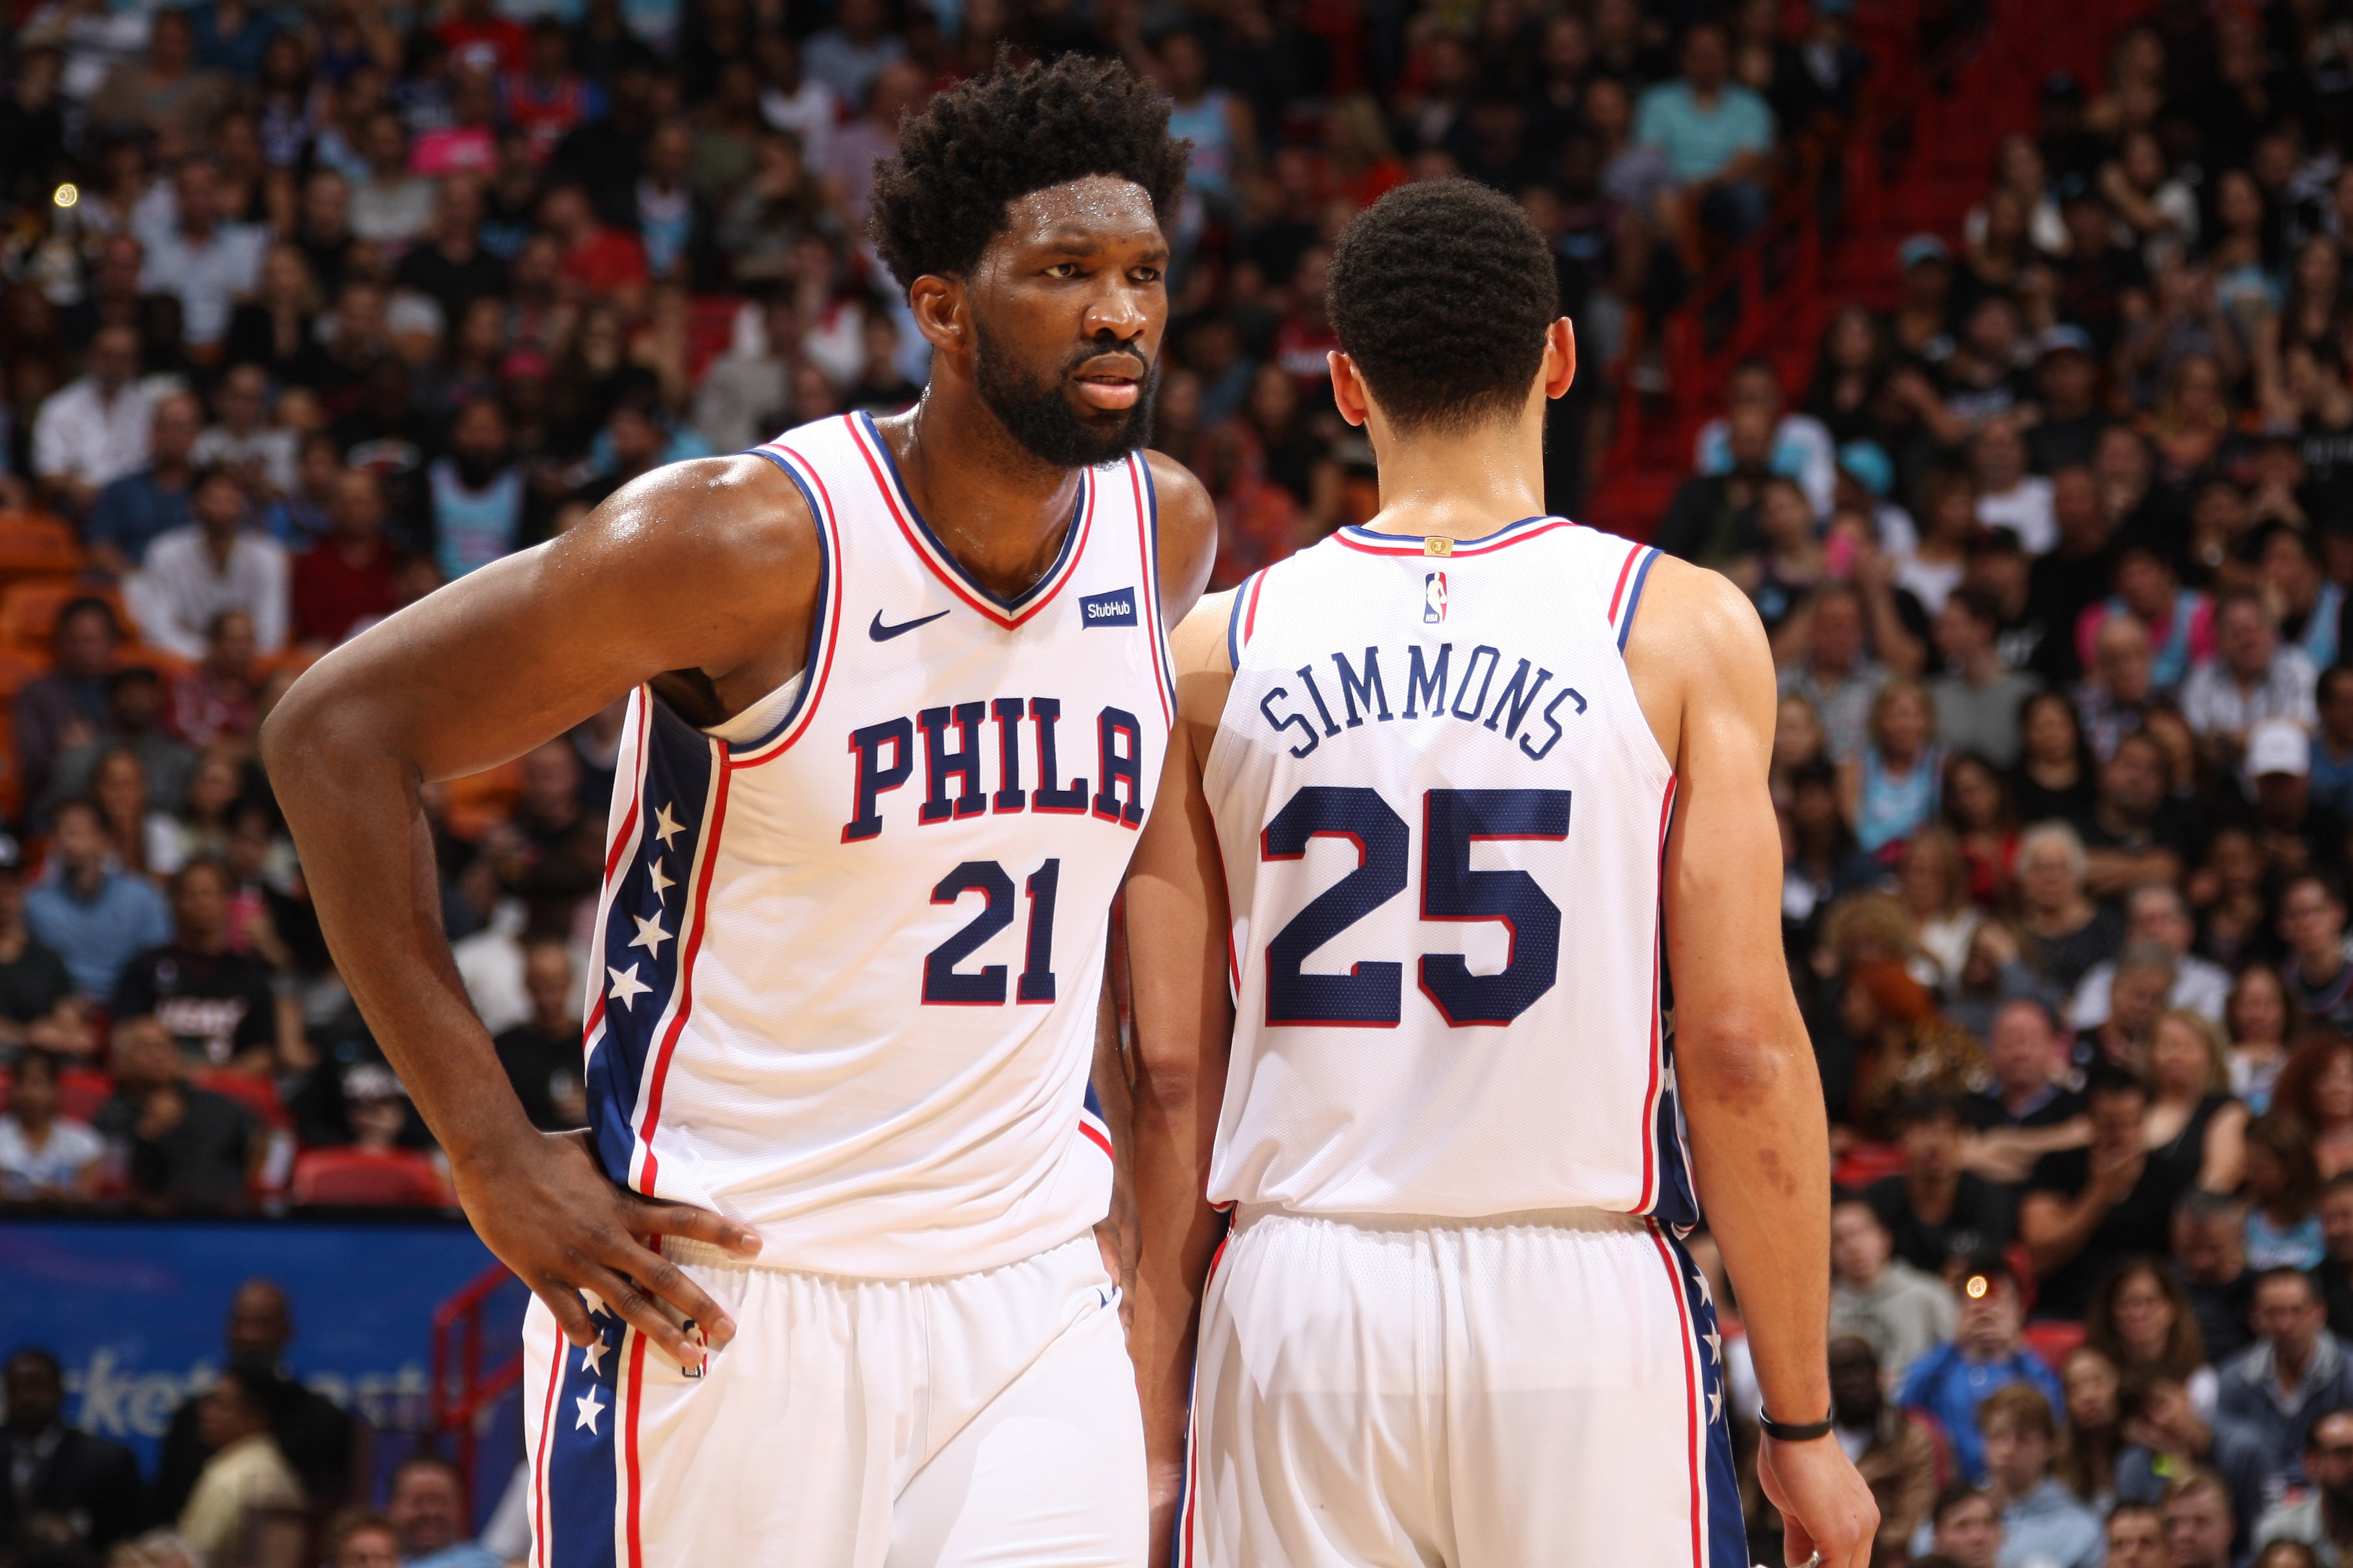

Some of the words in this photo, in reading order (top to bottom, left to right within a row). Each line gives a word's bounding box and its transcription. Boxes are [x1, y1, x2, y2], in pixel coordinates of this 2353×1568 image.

[1087, 600, 1131, 618] StubHub
[1425, 613, 1438, 622] NBA
[1259, 643, 1588, 761] SIMMONS
[840, 697, 1145, 844] PHILA
[921, 858, 1061, 1006] 21
[1260, 786, 1572, 1028] 25
